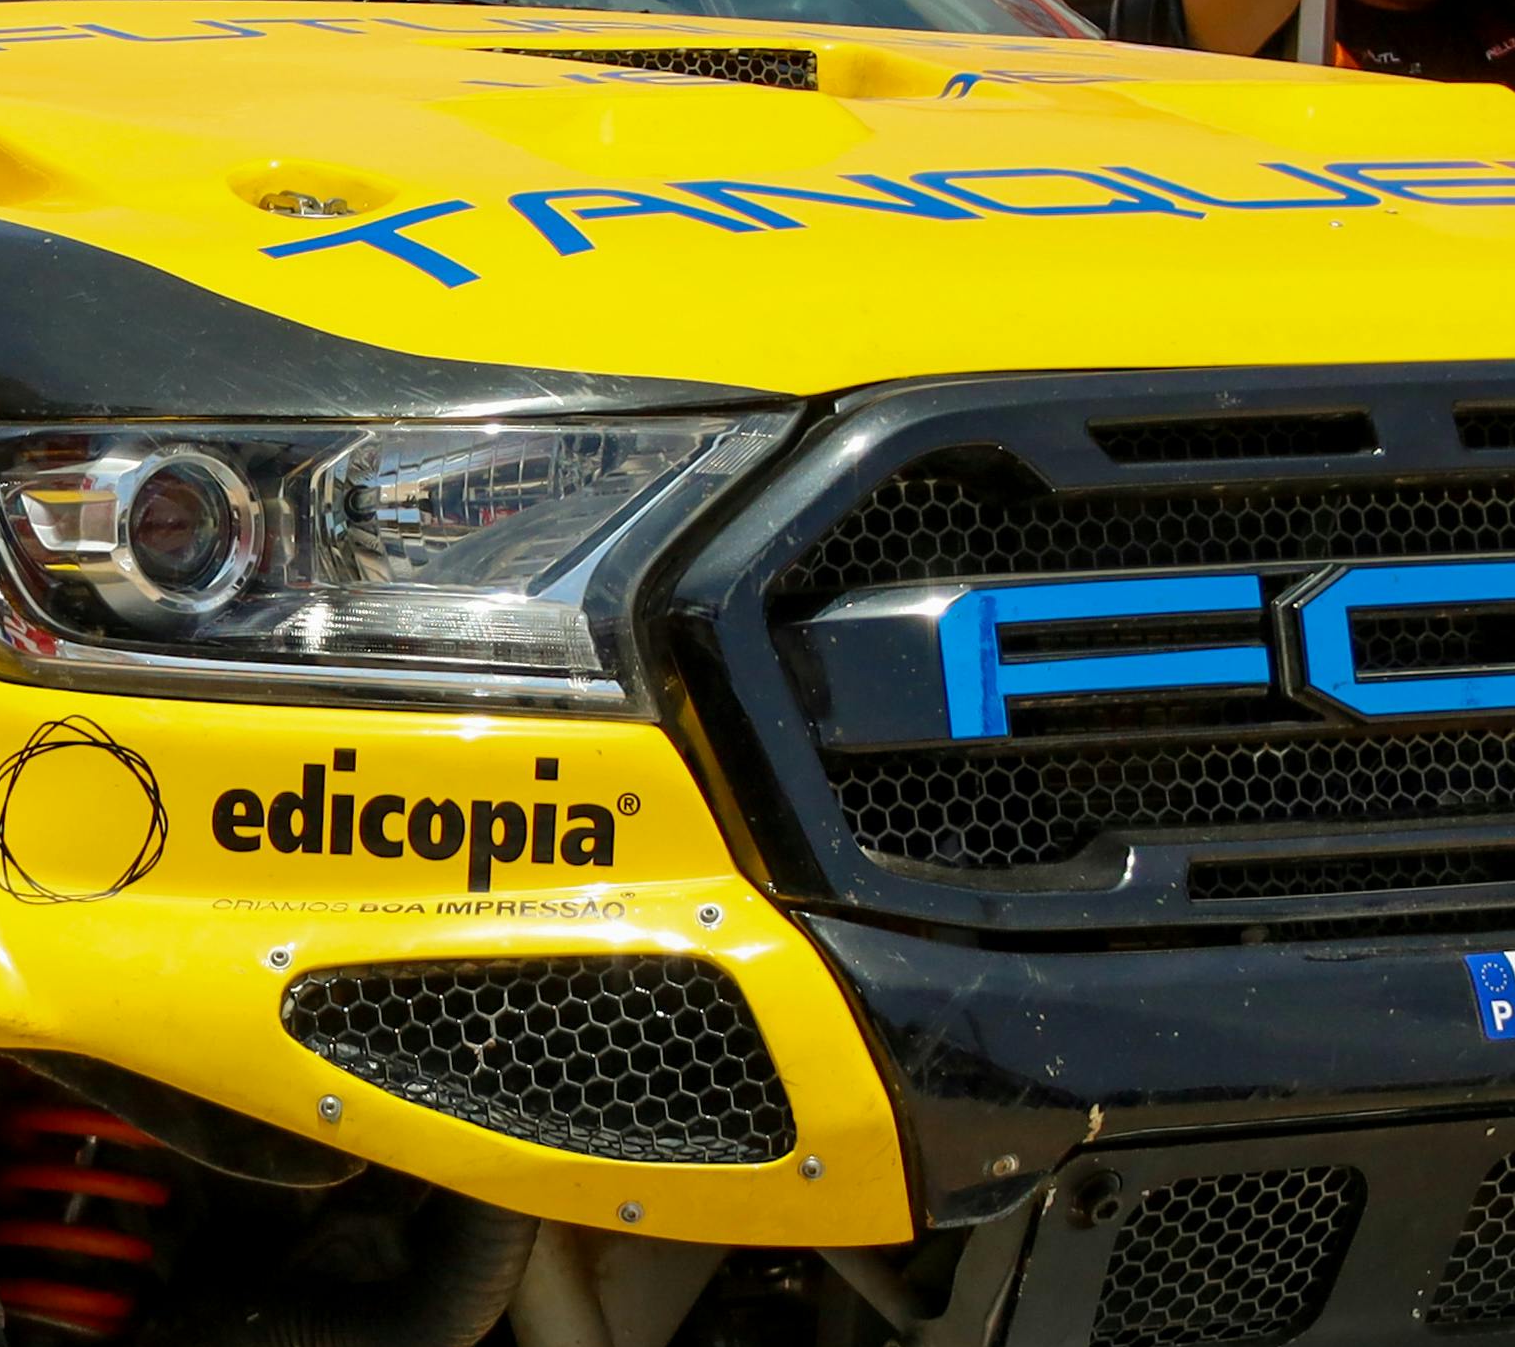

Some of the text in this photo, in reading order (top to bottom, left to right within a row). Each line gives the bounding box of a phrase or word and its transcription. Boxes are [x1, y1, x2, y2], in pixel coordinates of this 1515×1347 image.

[212, 897, 348, 914] CRIAMOS
[358, 902, 426, 915] BOA
[1491, 1000, 1513, 1031] P
